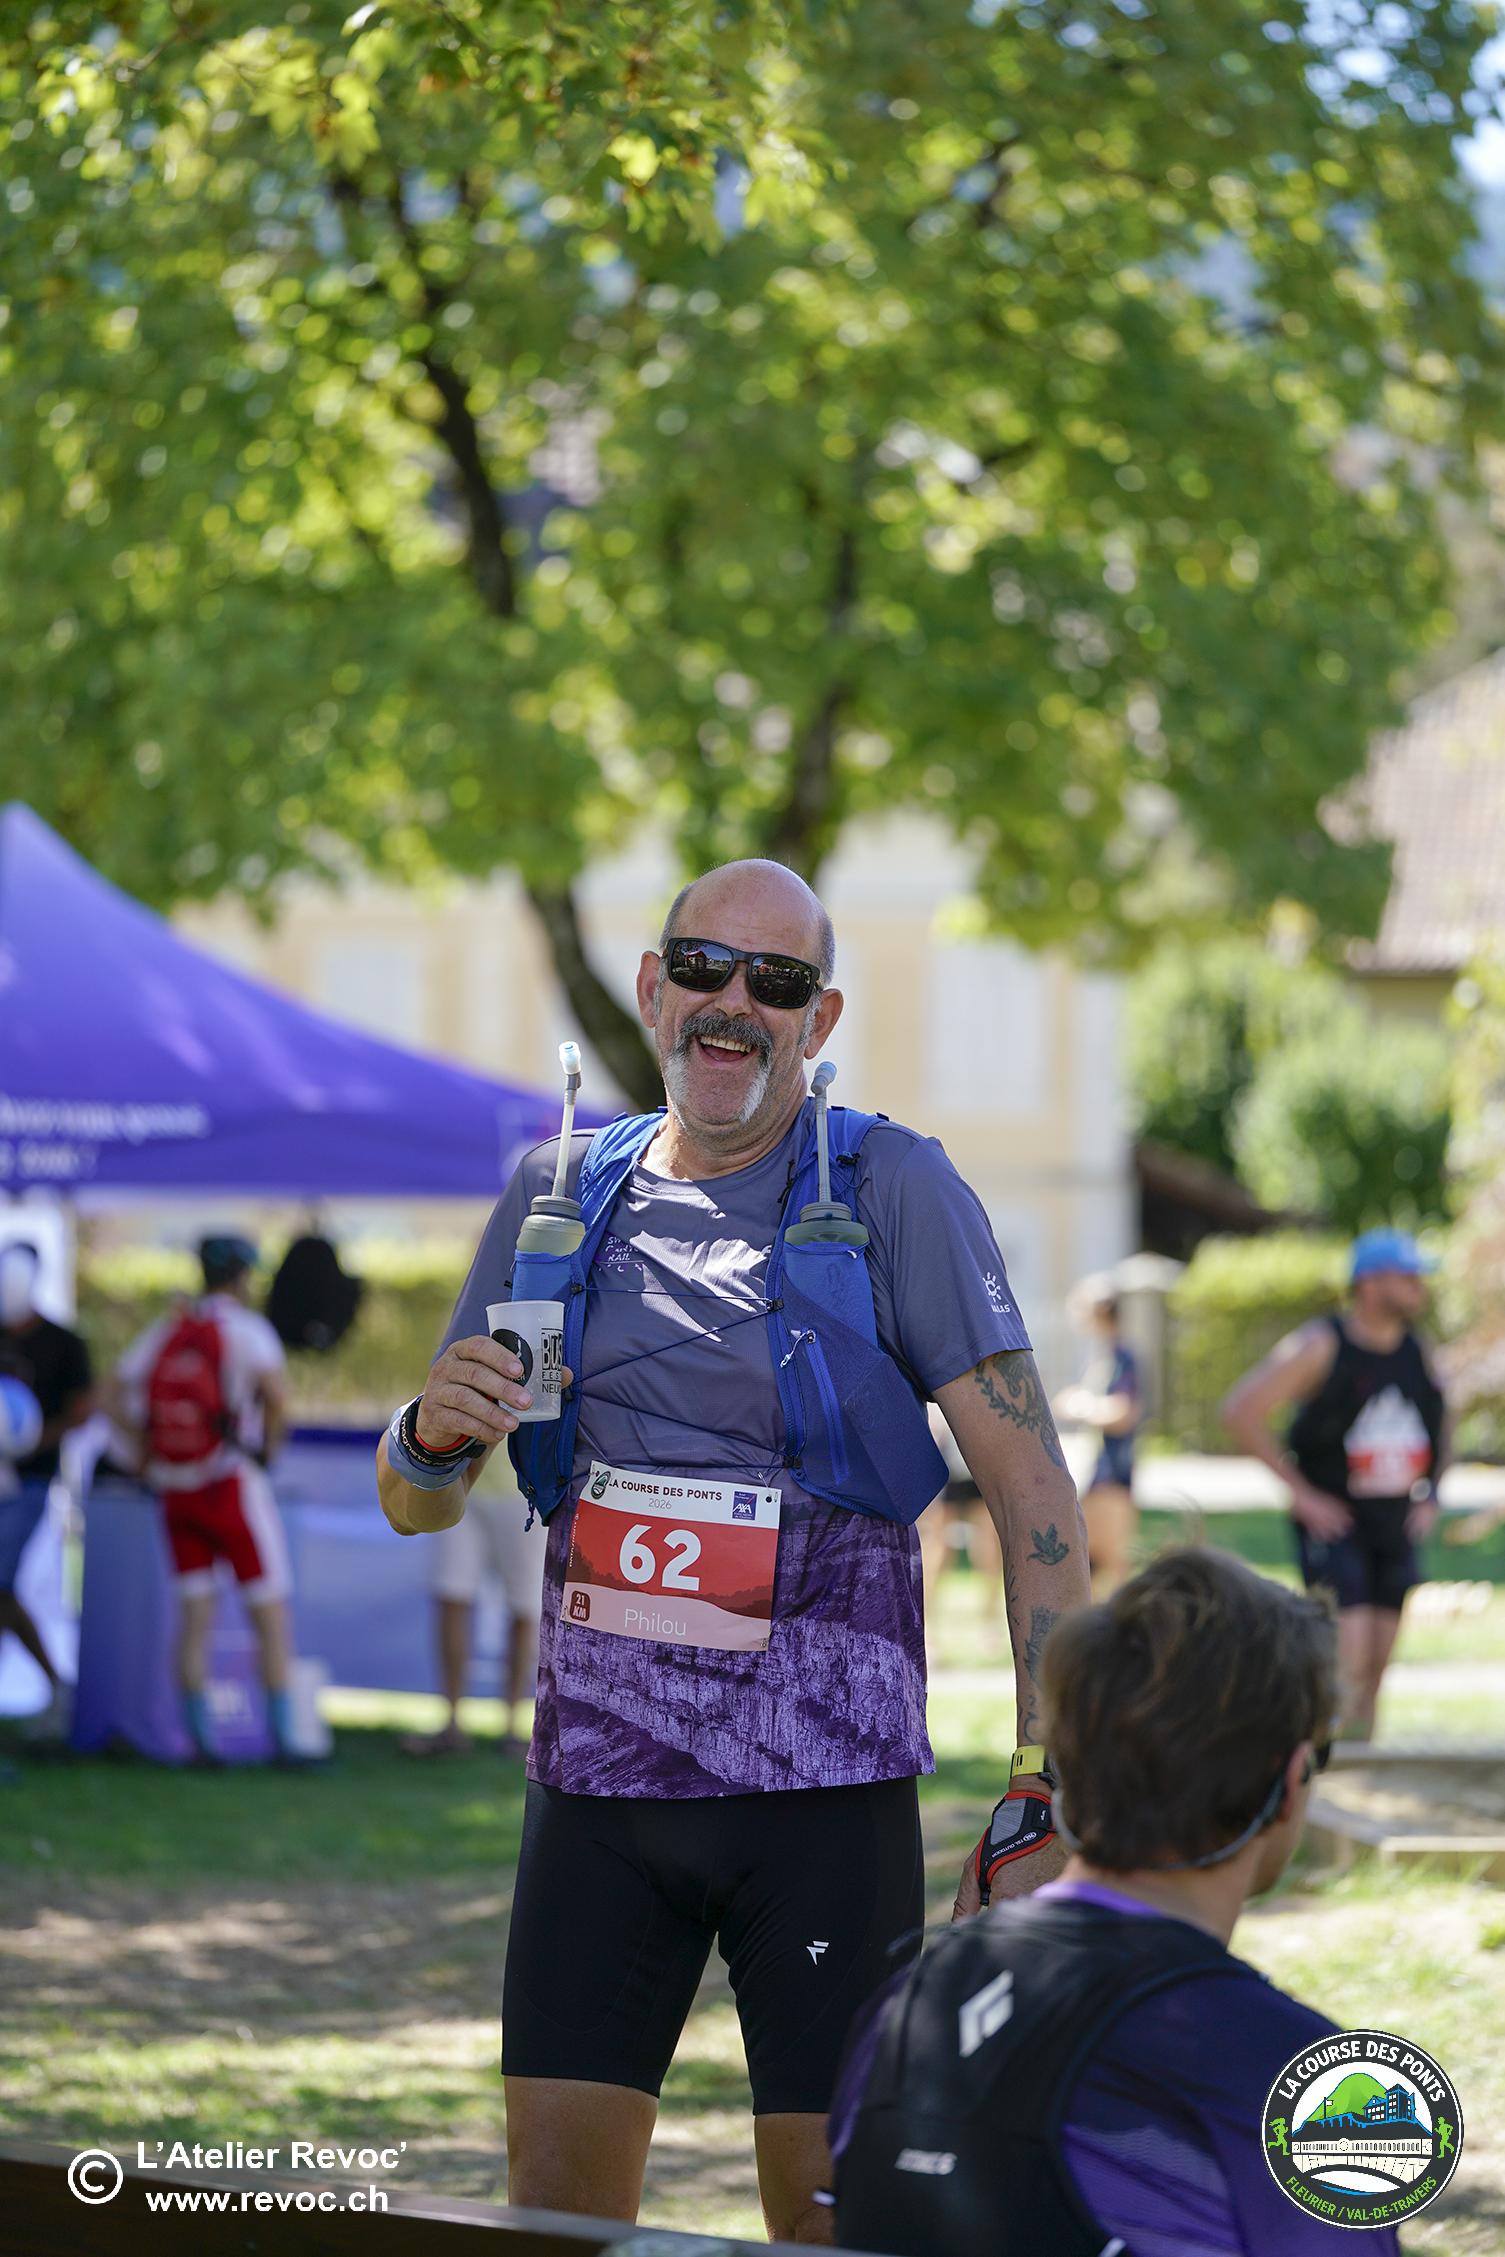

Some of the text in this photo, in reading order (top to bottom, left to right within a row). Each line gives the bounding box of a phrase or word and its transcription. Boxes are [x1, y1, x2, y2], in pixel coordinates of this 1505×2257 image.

[542, 1371, 562, 1380] FES
[621, 1480, 660, 1495] COURSE
[663, 1486, 684, 1498] DES
[686, 1489, 723, 1501] PONTS
[648, 1498, 673, 1510] 2026
[732, 1503, 752, 1514] AXA
[619, 1524, 702, 1592] 62
[576, 1593, 585, 1606] 21
[573, 1605, 587, 1619] KM
[624, 1608, 687, 1637] Philou
